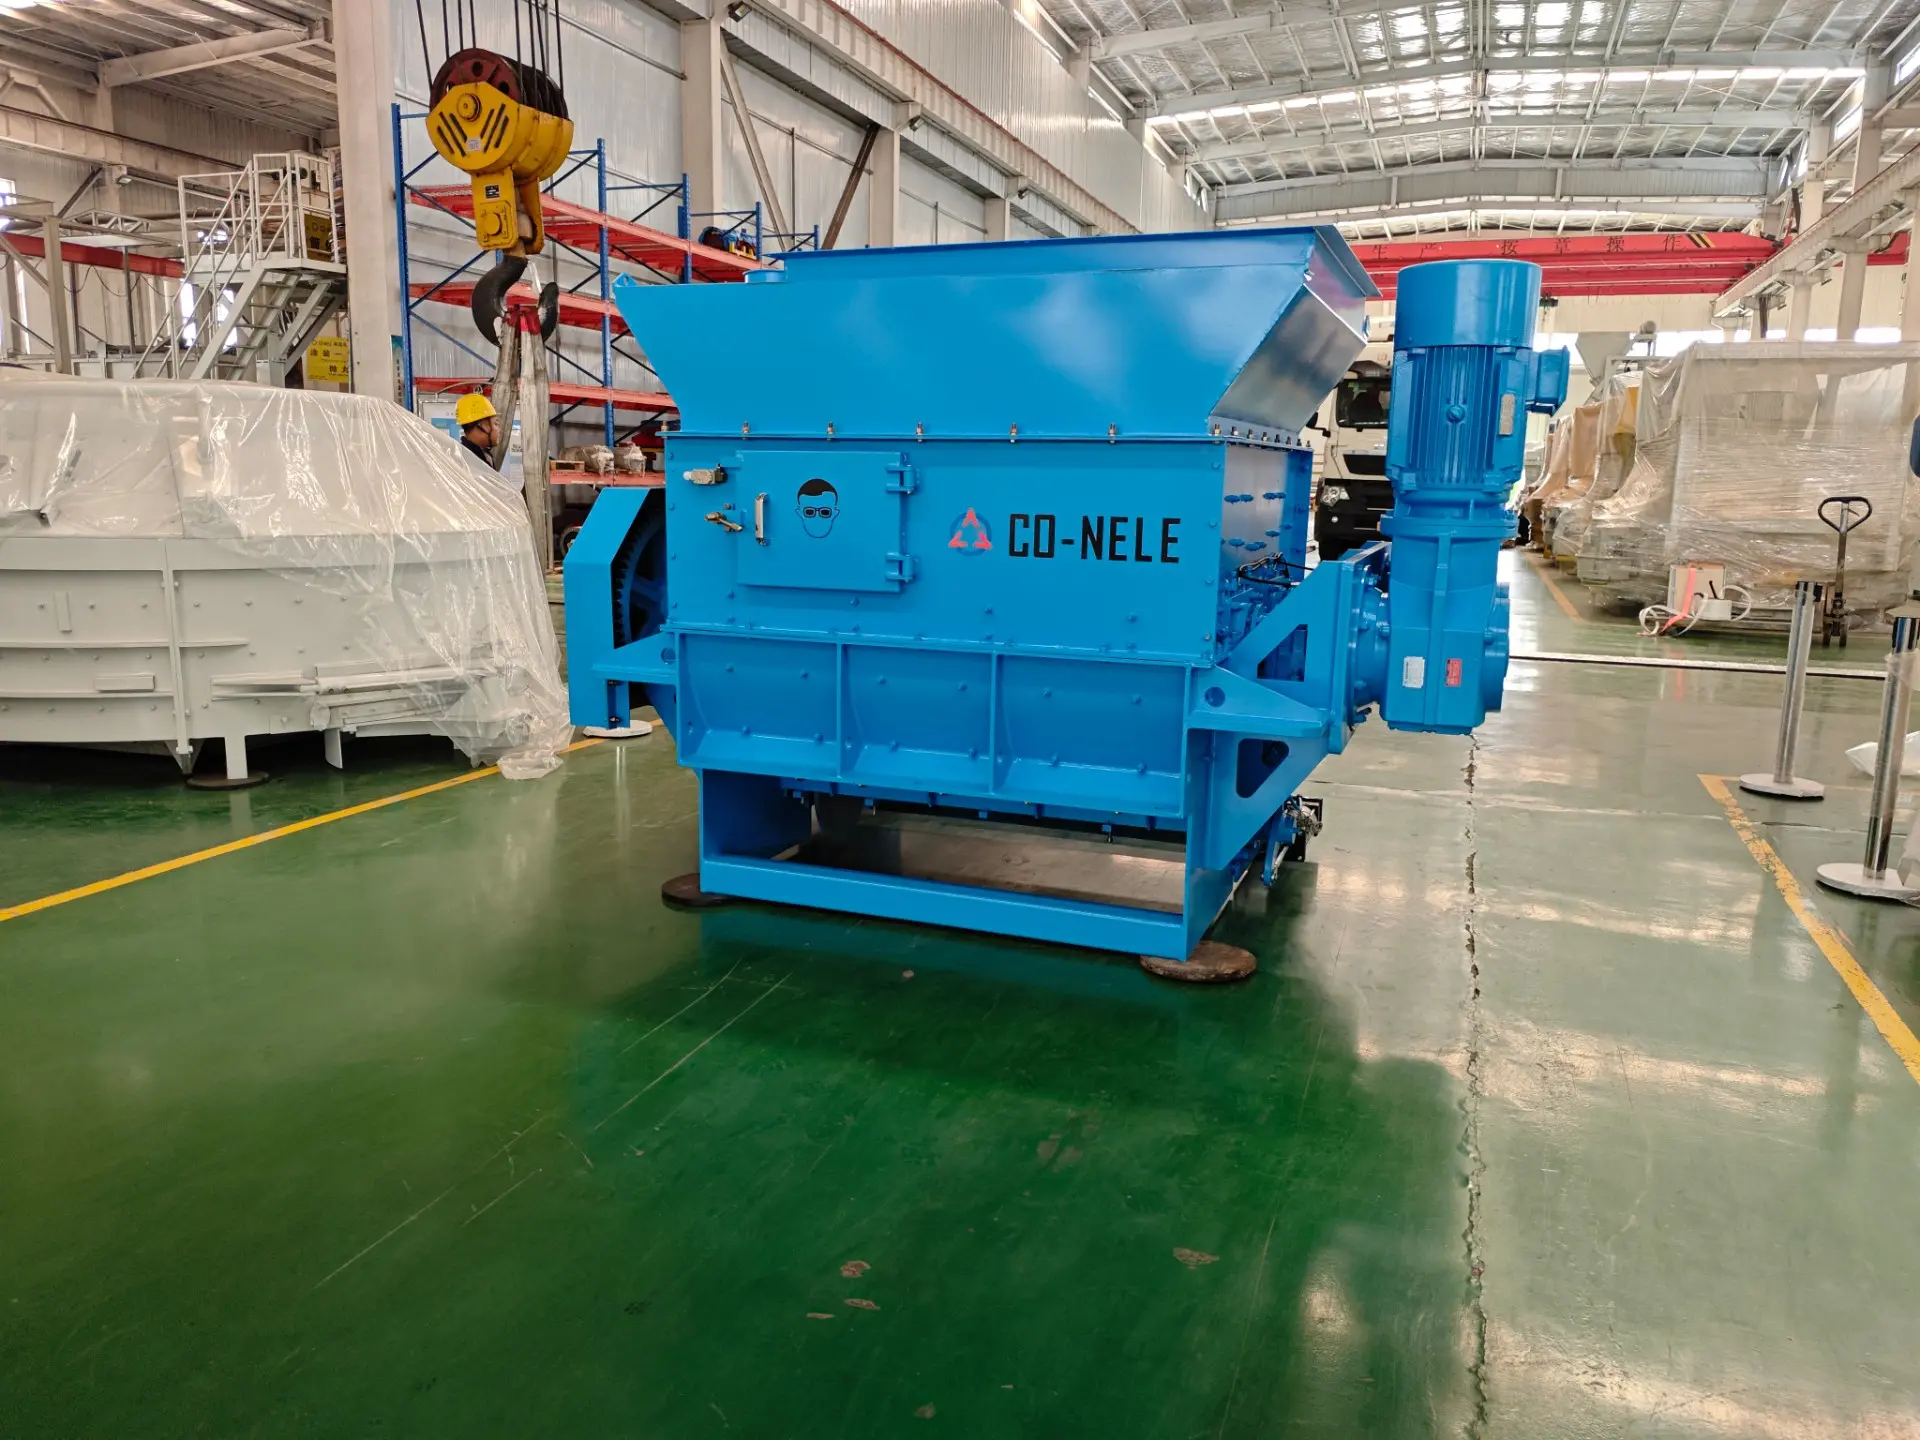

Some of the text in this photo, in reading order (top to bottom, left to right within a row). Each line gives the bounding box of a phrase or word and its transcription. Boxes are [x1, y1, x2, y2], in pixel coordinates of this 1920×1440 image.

[1501, 234, 1684, 257] 按章操作
[1009, 513, 1181, 564] CO-NELE
